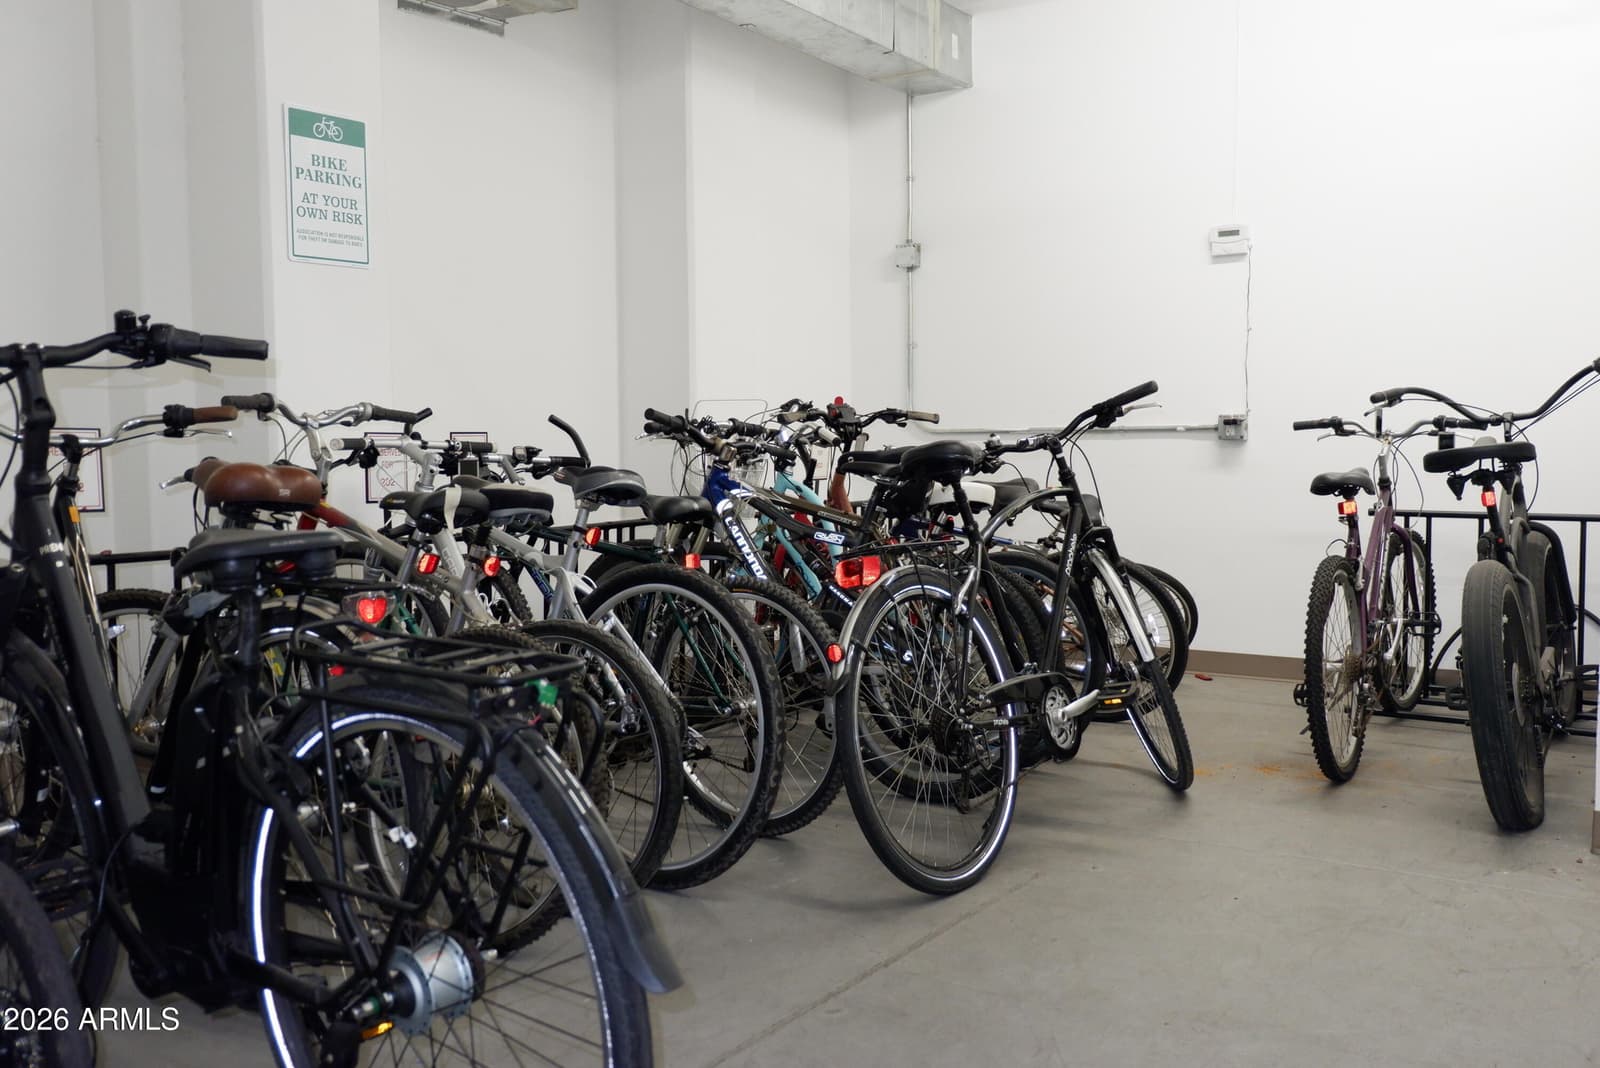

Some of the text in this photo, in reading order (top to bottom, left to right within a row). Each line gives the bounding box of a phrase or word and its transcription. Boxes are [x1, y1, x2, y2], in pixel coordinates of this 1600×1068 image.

[311, 154, 347, 172] BIKE
[295, 166, 362, 189] PARKING
[301, 192, 358, 210] AT YOUR
[296, 205, 363, 225] OWN RISK
